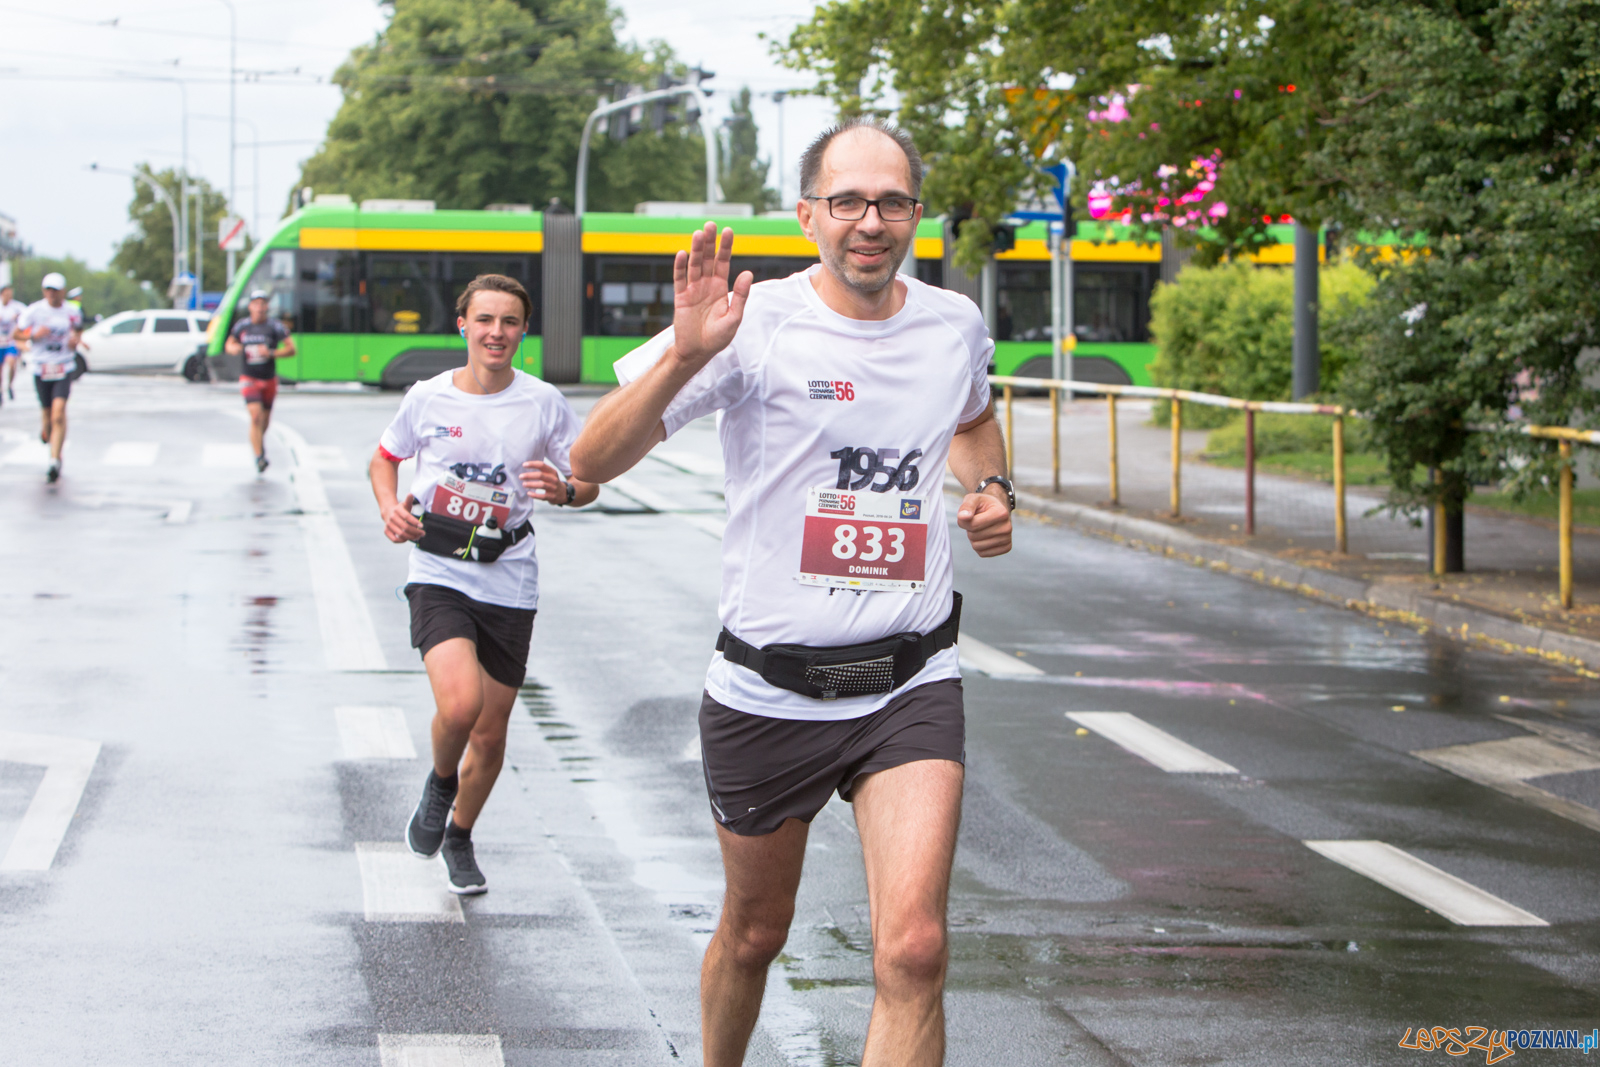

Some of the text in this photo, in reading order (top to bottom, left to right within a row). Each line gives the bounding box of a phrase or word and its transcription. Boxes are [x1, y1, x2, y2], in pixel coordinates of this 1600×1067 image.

[807, 380, 830, 388] LOTTO
[449, 462, 507, 486] 1956
[830, 446, 923, 493] 1956
[819, 492, 837, 500] LOTTO
[446, 495, 494, 526] 801
[832, 524, 906, 563] 833
[848, 565, 889, 576] DOMINIK
